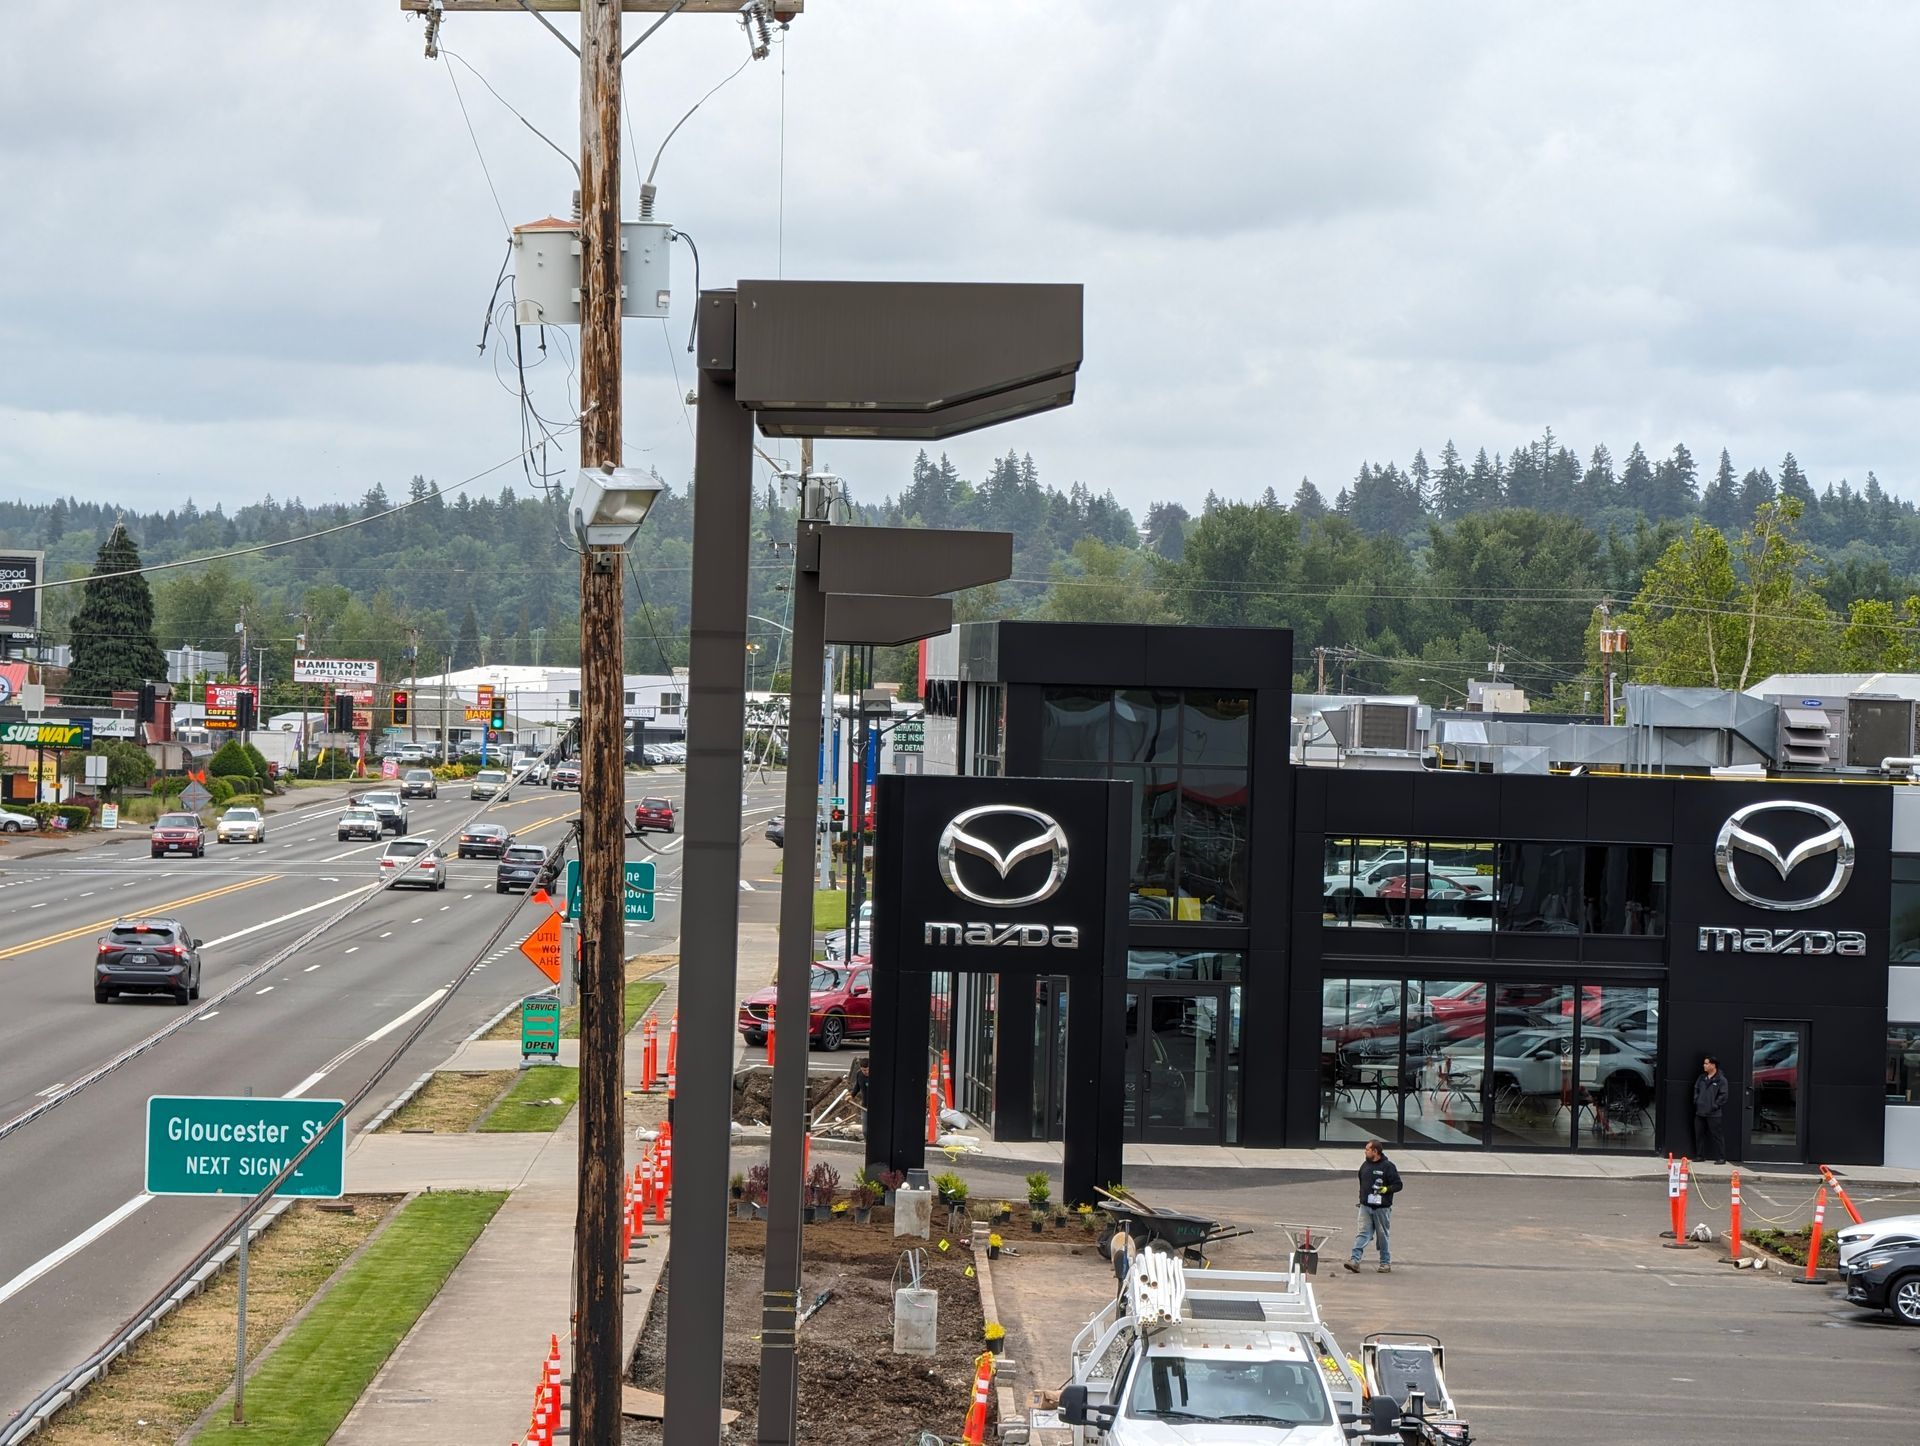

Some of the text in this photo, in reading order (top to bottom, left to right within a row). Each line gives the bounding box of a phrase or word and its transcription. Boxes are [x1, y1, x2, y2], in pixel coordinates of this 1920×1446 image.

[297, 661, 375, 670] HAMILTON'S
[305, 669, 367, 677] APPLIANCE
[216, 697, 237, 706] Gri
[465, 710, 492, 720] MARK
[1, 725, 82, 743] SUBWAY
[907, 734, 924, 742] INSI
[904, 744, 924, 752] DETAI
[624, 905, 648, 914] GNAL
[537, 932, 560, 942] UTIL
[541, 944, 560, 954] WO
[539, 957, 560, 966] AHE
[525, 1003, 558, 1011] SERVICE
[525, 1041, 555, 1050] OPEN
[168, 1116, 289, 1143] Gloucester
[186, 1156, 231, 1175] NEXT
